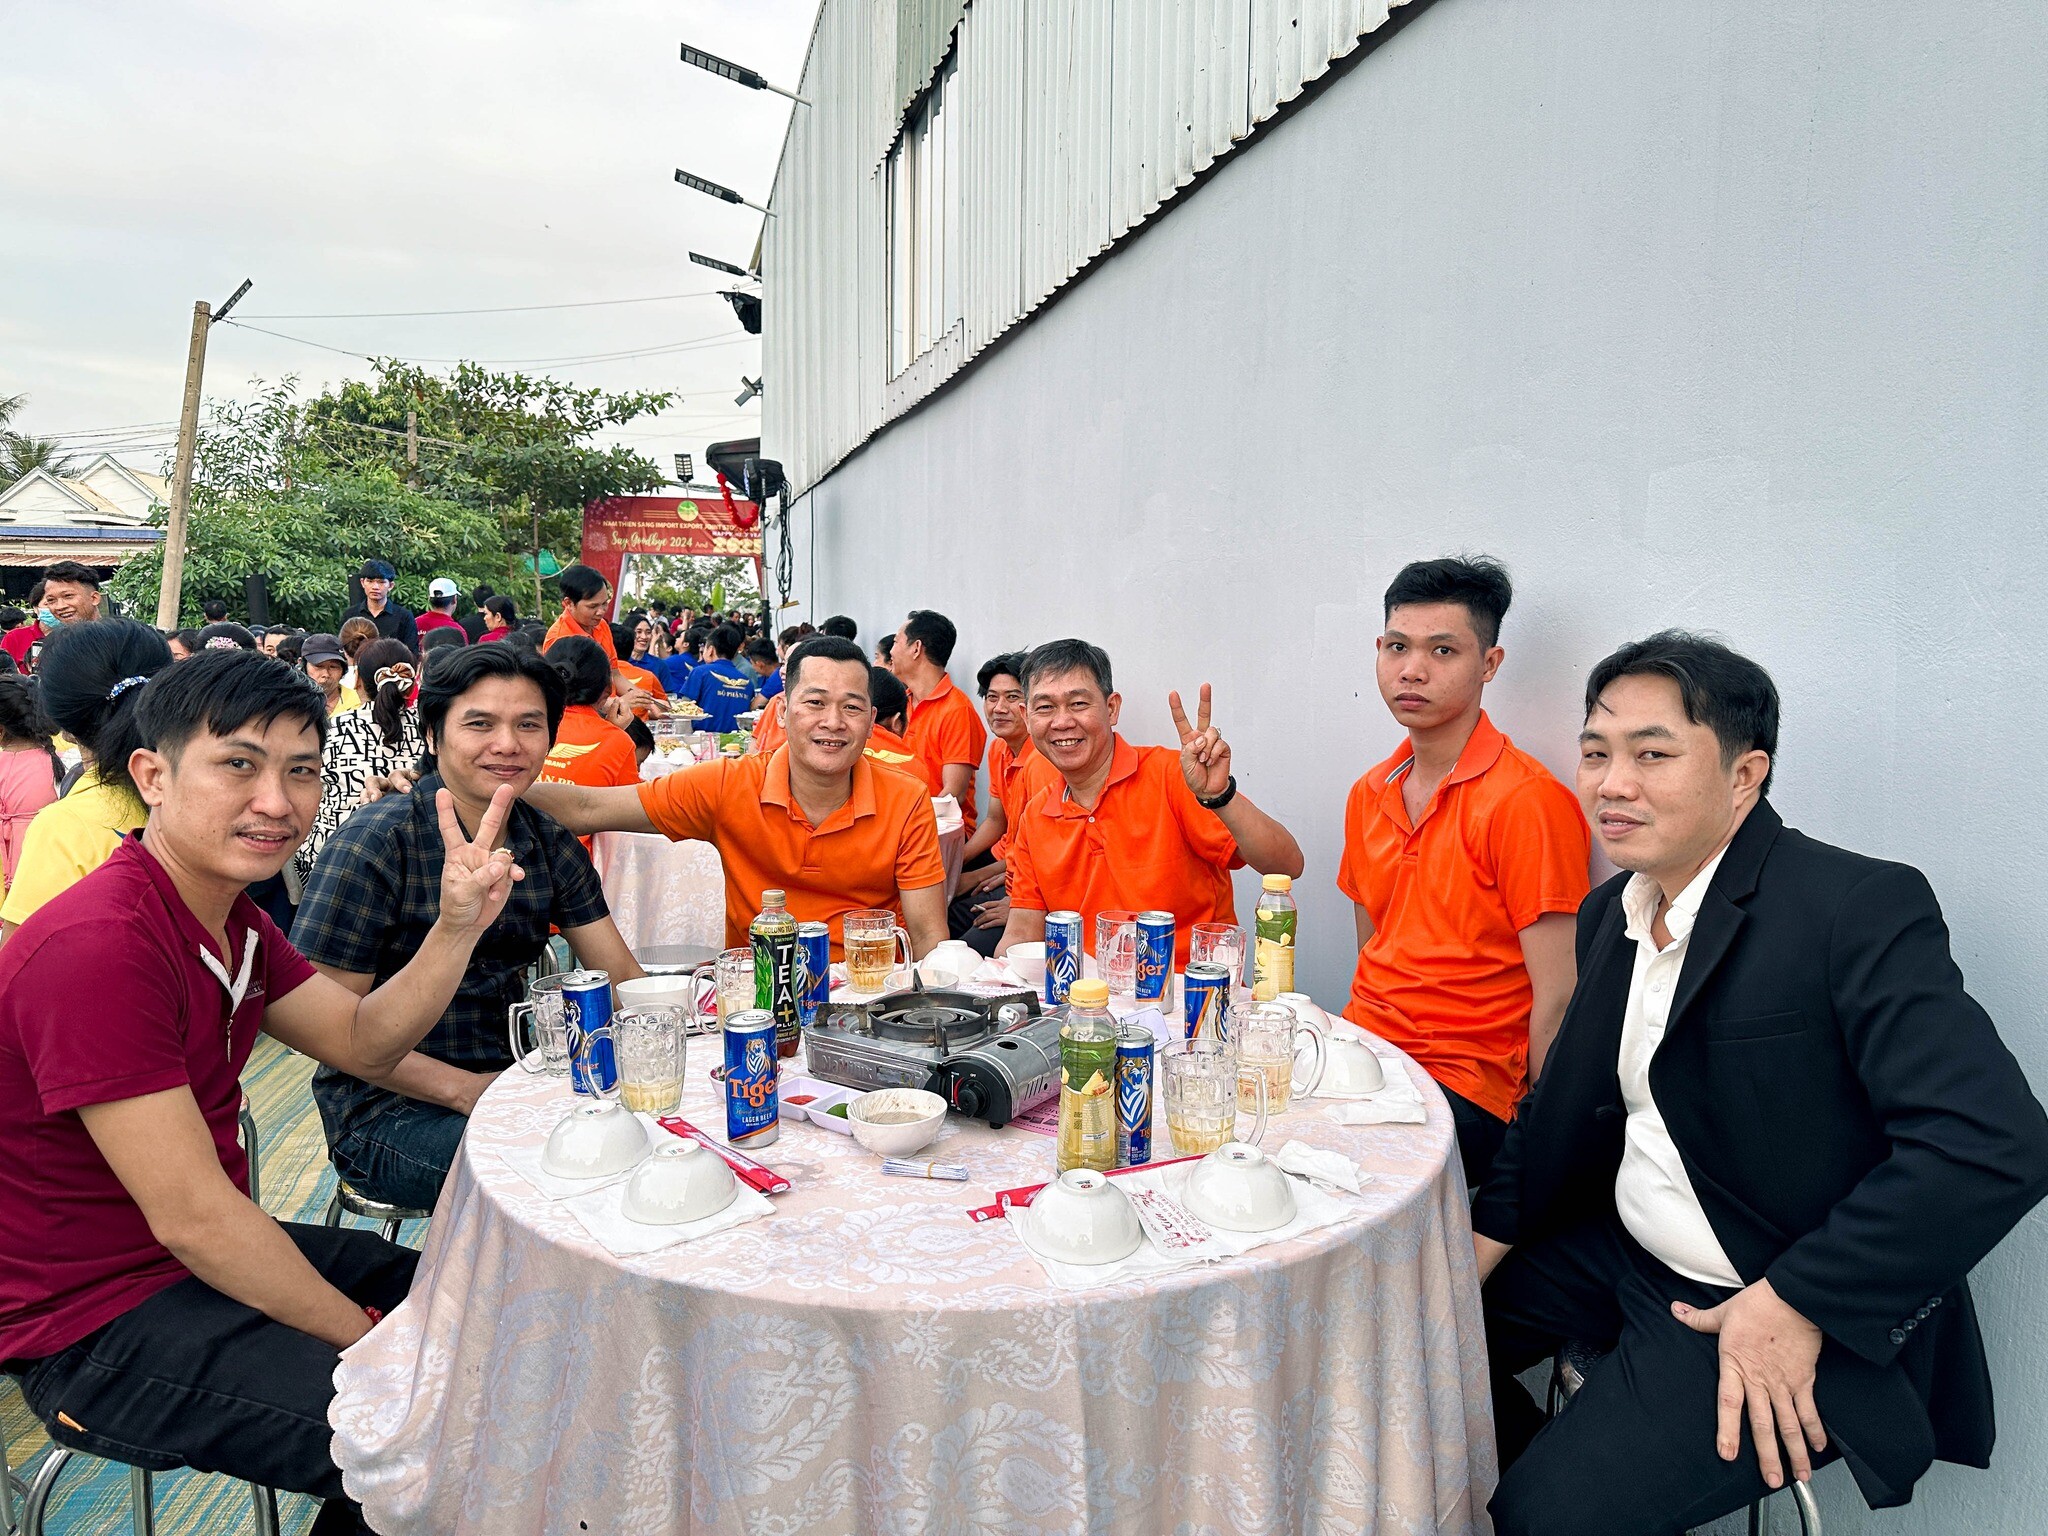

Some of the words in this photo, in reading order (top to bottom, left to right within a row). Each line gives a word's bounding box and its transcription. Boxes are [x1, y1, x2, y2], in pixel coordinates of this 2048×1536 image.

[612, 530, 629, 550] Say
[630, 531, 668, 551] Goodbye
[670, 536, 693, 548] 2024
[776, 1020, 797, 1028] PLUS
